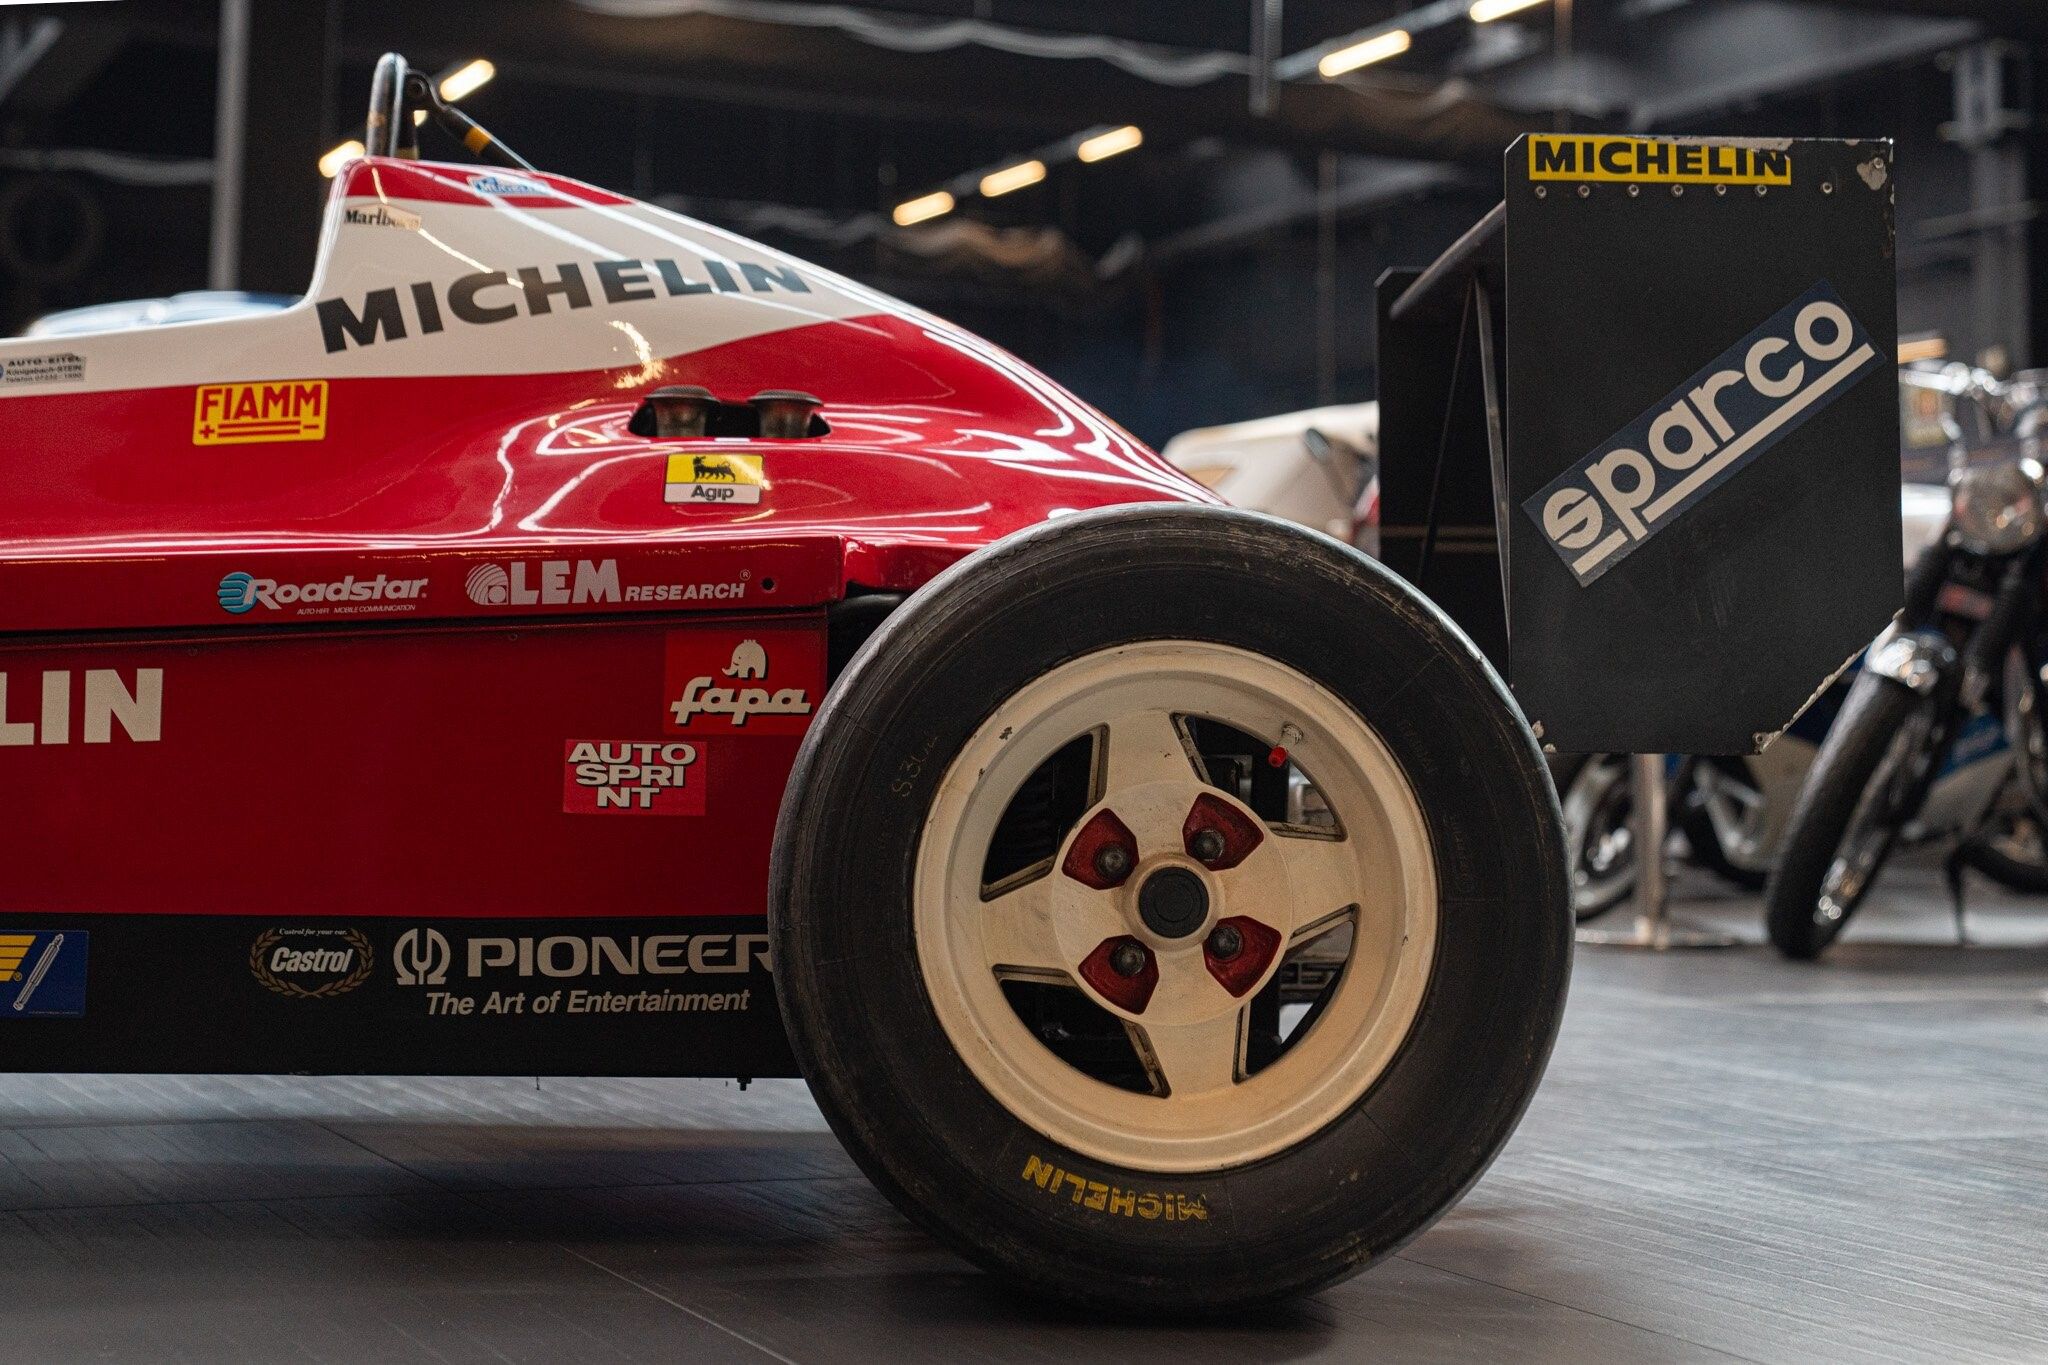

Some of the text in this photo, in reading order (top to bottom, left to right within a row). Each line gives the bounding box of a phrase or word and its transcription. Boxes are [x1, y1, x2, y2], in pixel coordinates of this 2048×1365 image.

[1535, 140, 1788, 177] MICHELIN
[344, 206, 420, 230] Marlb
[316, 259, 812, 354] MICHELIN
[201, 384, 322, 421] FIAMM
[1542, 300, 1854, 551] sparco
[691, 485, 735, 501] Agip
[243, 574, 429, 610] Roadstar
[510, 558, 746, 606] LEM RESEARCH
[670, 676, 812, 725] fapa
[568, 742, 696, 765] AUTO
[575, 763, 685, 787] SPRI
[597, 786, 660, 808] NT
[270, 946, 354, 973] Castrol
[467, 933, 774, 978] PIONEER
[426, 988, 751, 1016] The Art of Entertainment
[1021, 1154, 1208, 1222] MICHELIN
